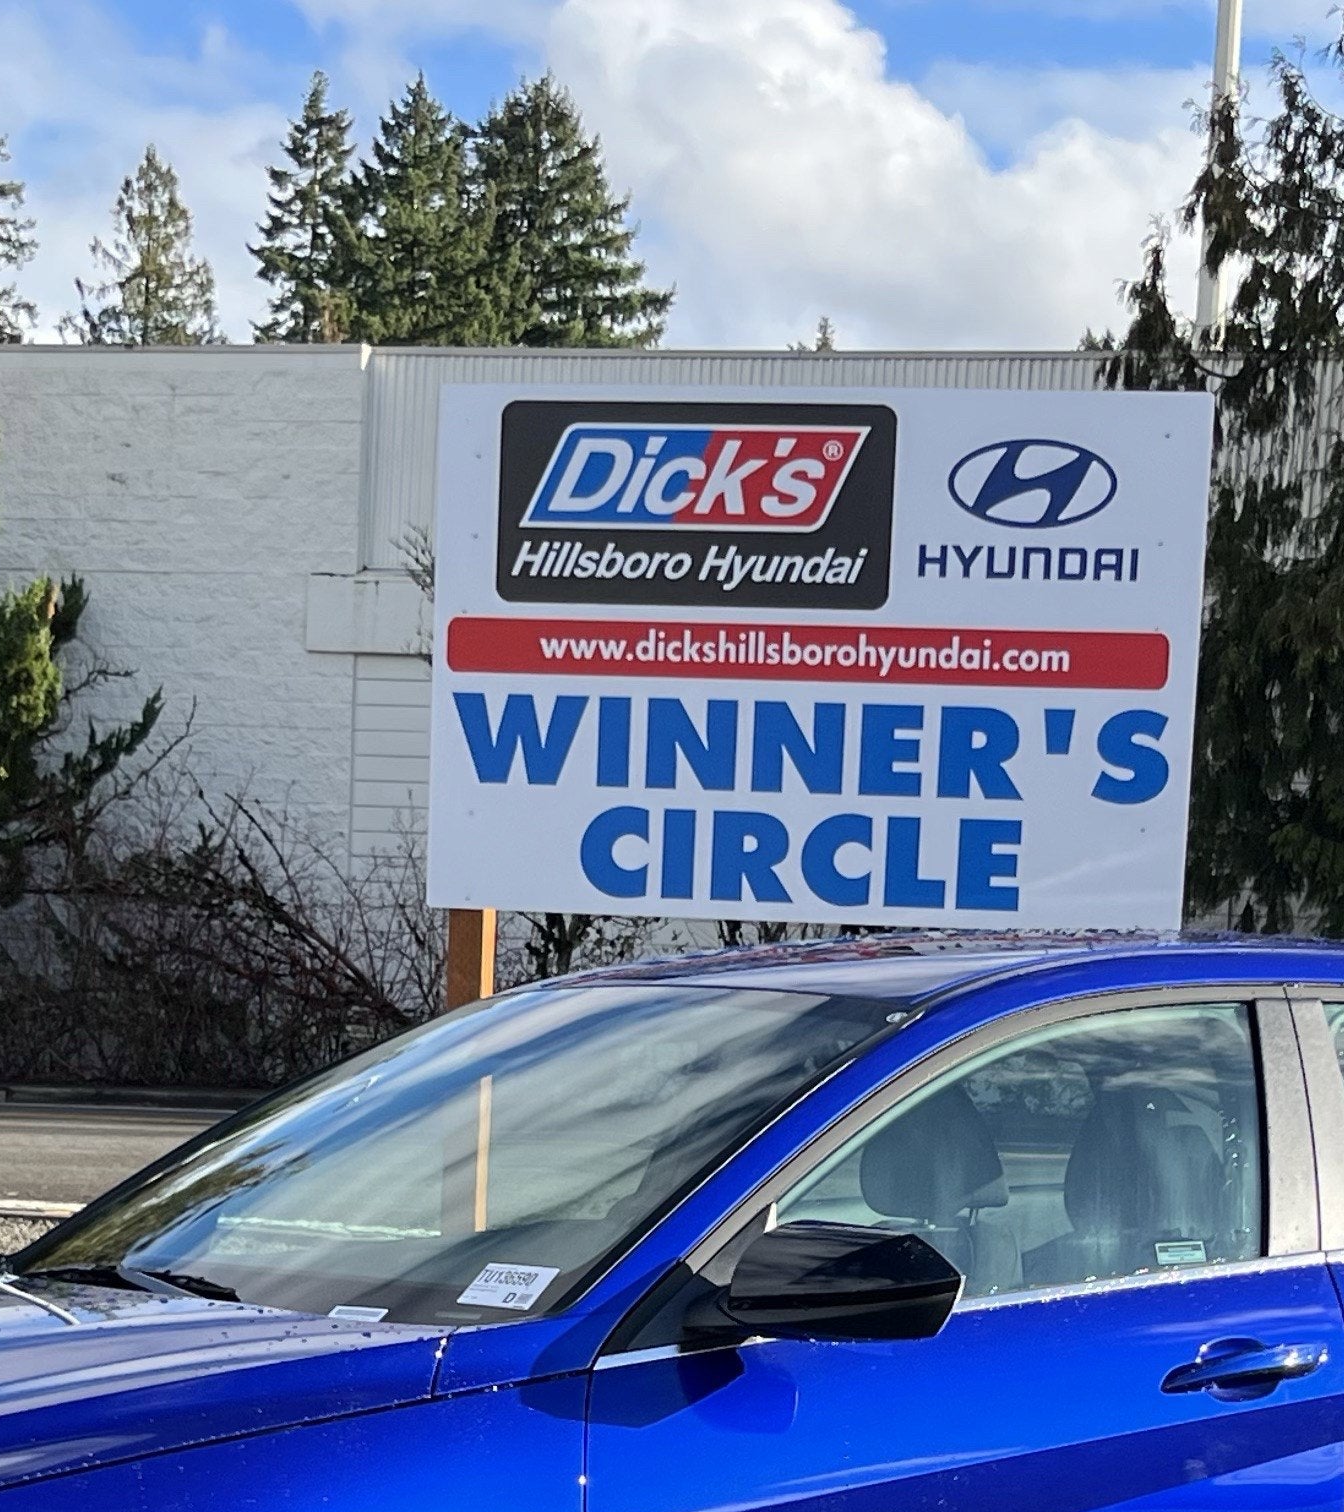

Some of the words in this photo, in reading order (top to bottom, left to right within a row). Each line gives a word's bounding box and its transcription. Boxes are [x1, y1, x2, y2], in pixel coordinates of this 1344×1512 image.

[546, 433, 827, 518] Dick's
[510, 541, 693, 582] Hillsboro
[697, 546, 868, 592] Hyundai
[916, 543, 1139, 583] HYUNDAI
[540, 629, 1070, 678] www.dickshillsborohyundai.com
[452, 691, 1171, 805] WINNER'S
[580, 806, 1024, 913] CIRCLE
